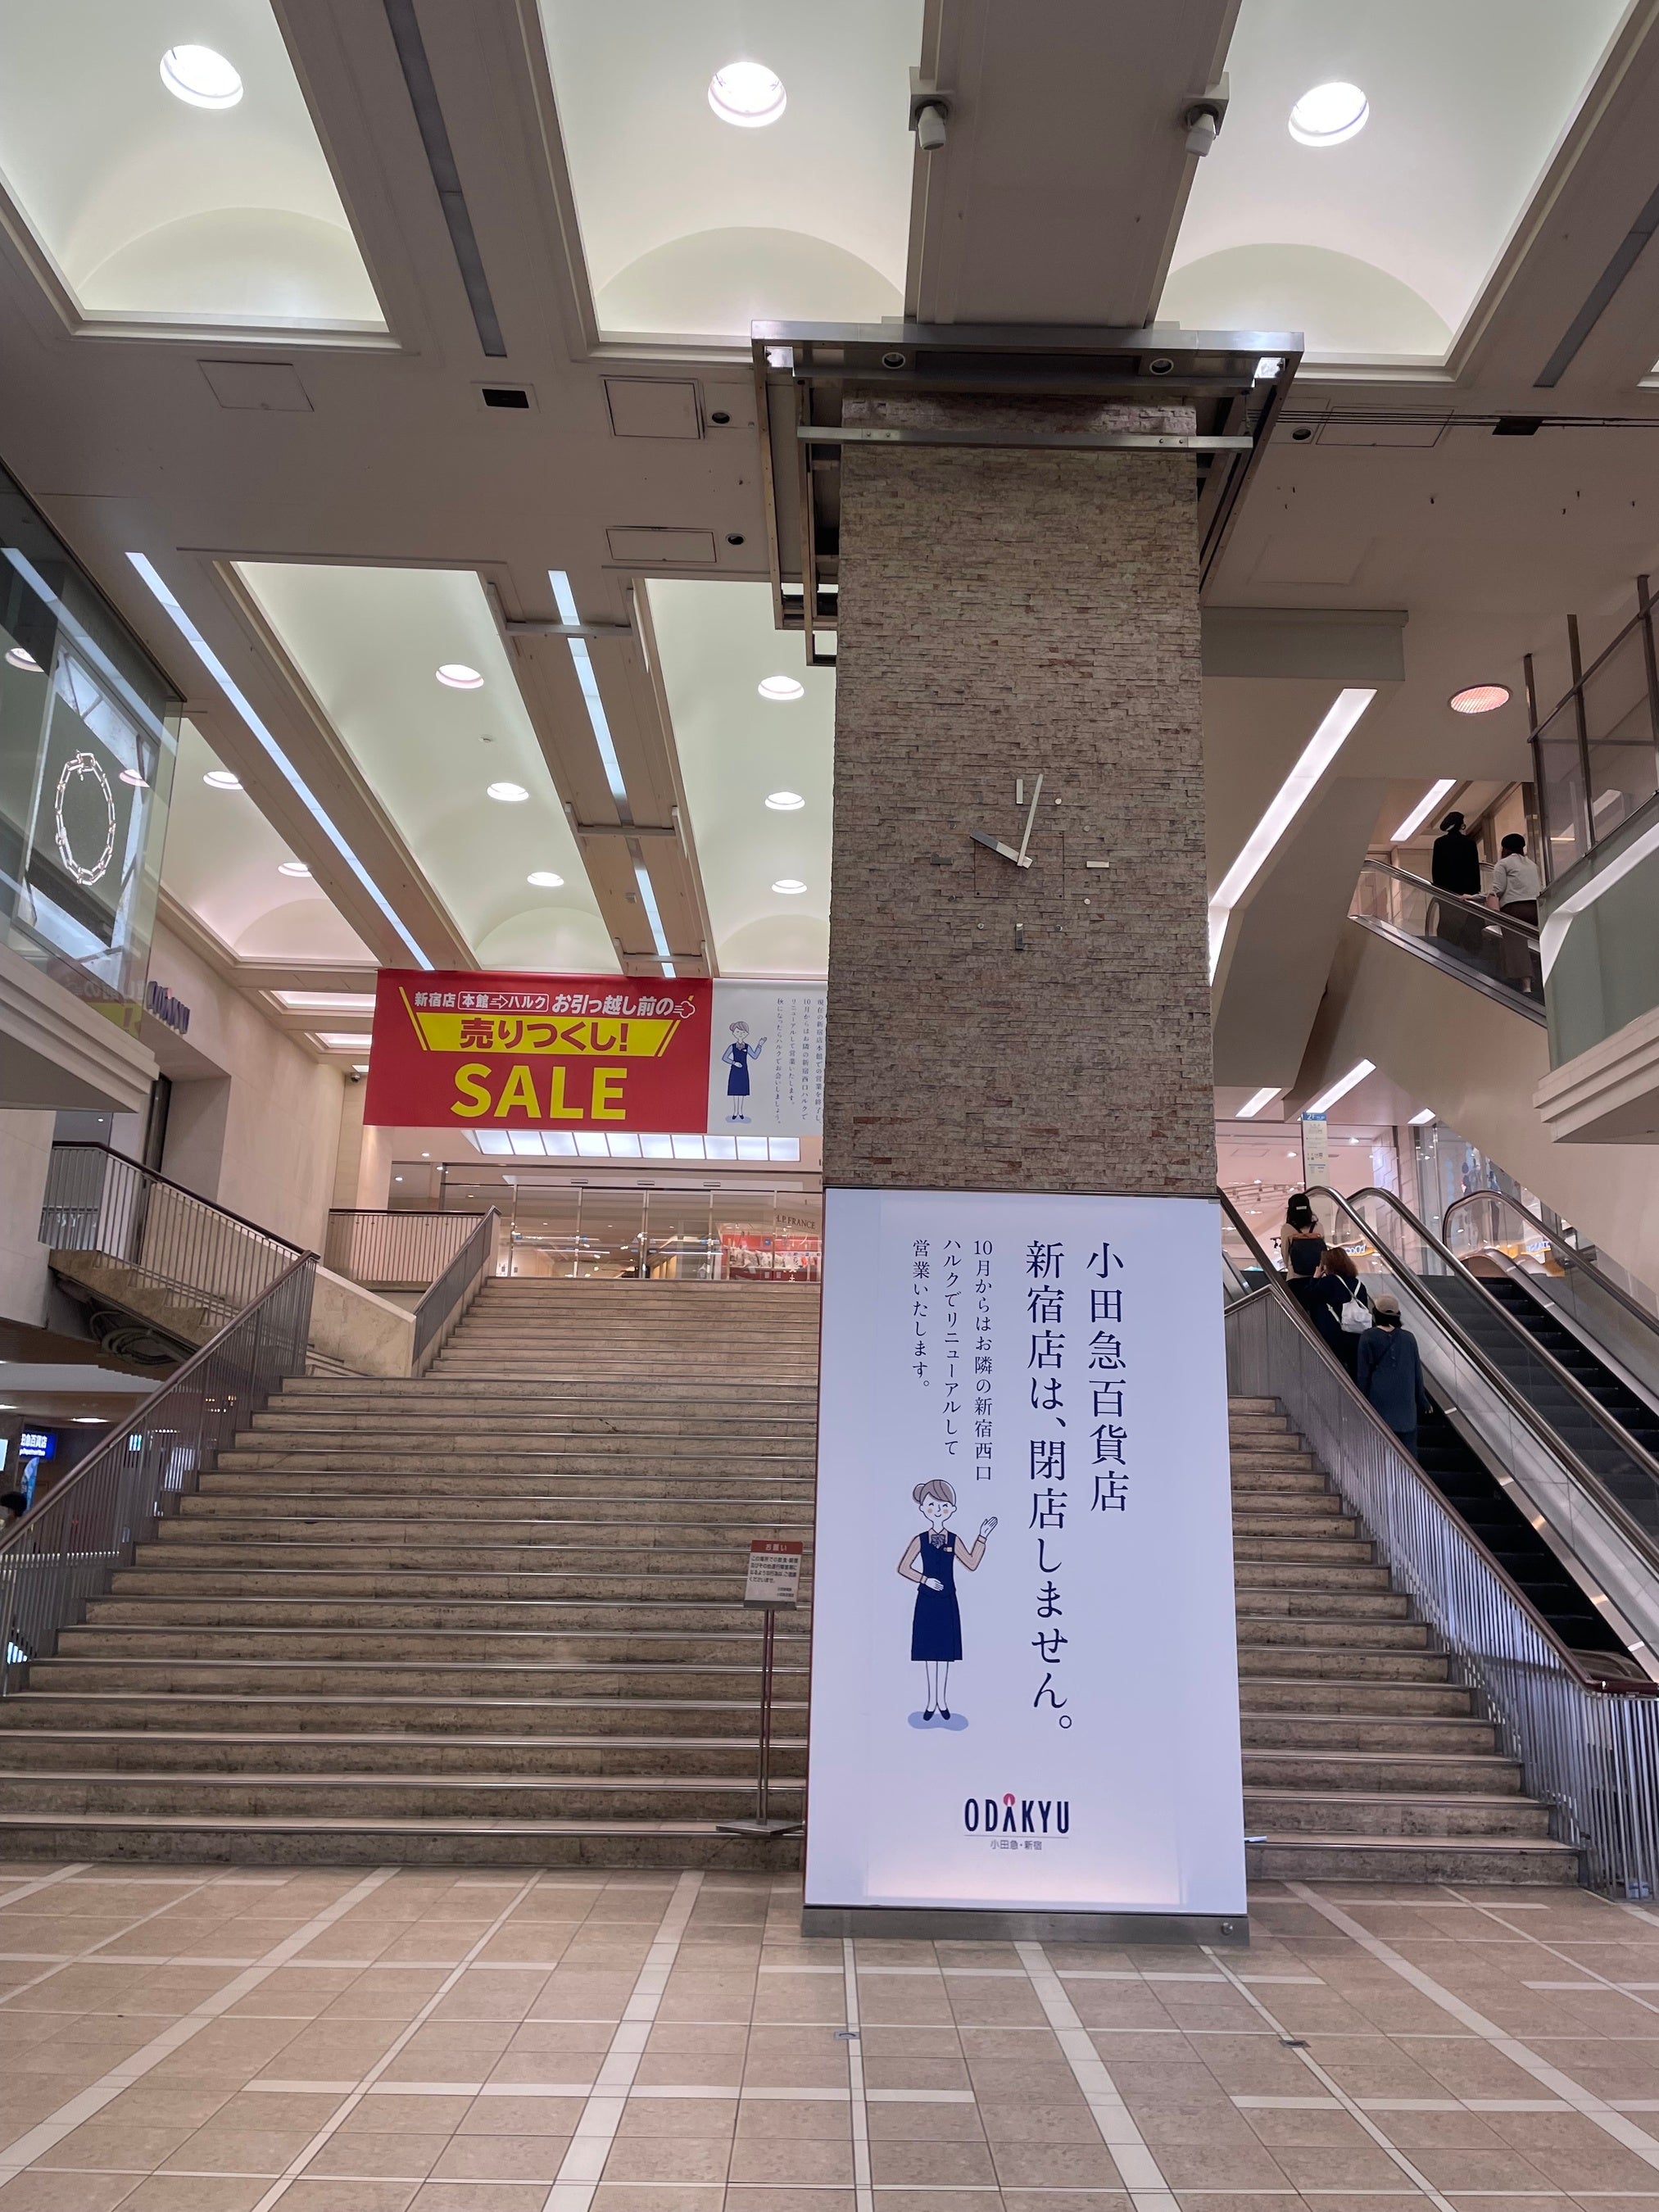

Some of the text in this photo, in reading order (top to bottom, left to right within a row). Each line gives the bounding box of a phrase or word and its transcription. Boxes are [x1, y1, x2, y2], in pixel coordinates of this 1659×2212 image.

[414, 991, 675, 1017] 新宿店 本館 ハルク お引っ越し前の
[460, 1018, 630, 1052] 売りつくし!
[451, 1063, 628, 1120] SALE
[912, 1240, 931, 1388] 営業いたします。
[942, 1240, 962, 1456] ハルクでリニューアルして
[973, 1240, 994, 1480] 10月からはお隣の新宿西口
[1086, 1240, 1129, 1512] 小田急百貨店
[1026, 1240, 1072, 1729] 新宿店は、閉店しません。
[964, 1793, 1069, 1834] ODAKYU
[990, 1839, 1042, 1850] 小田急・新宿
